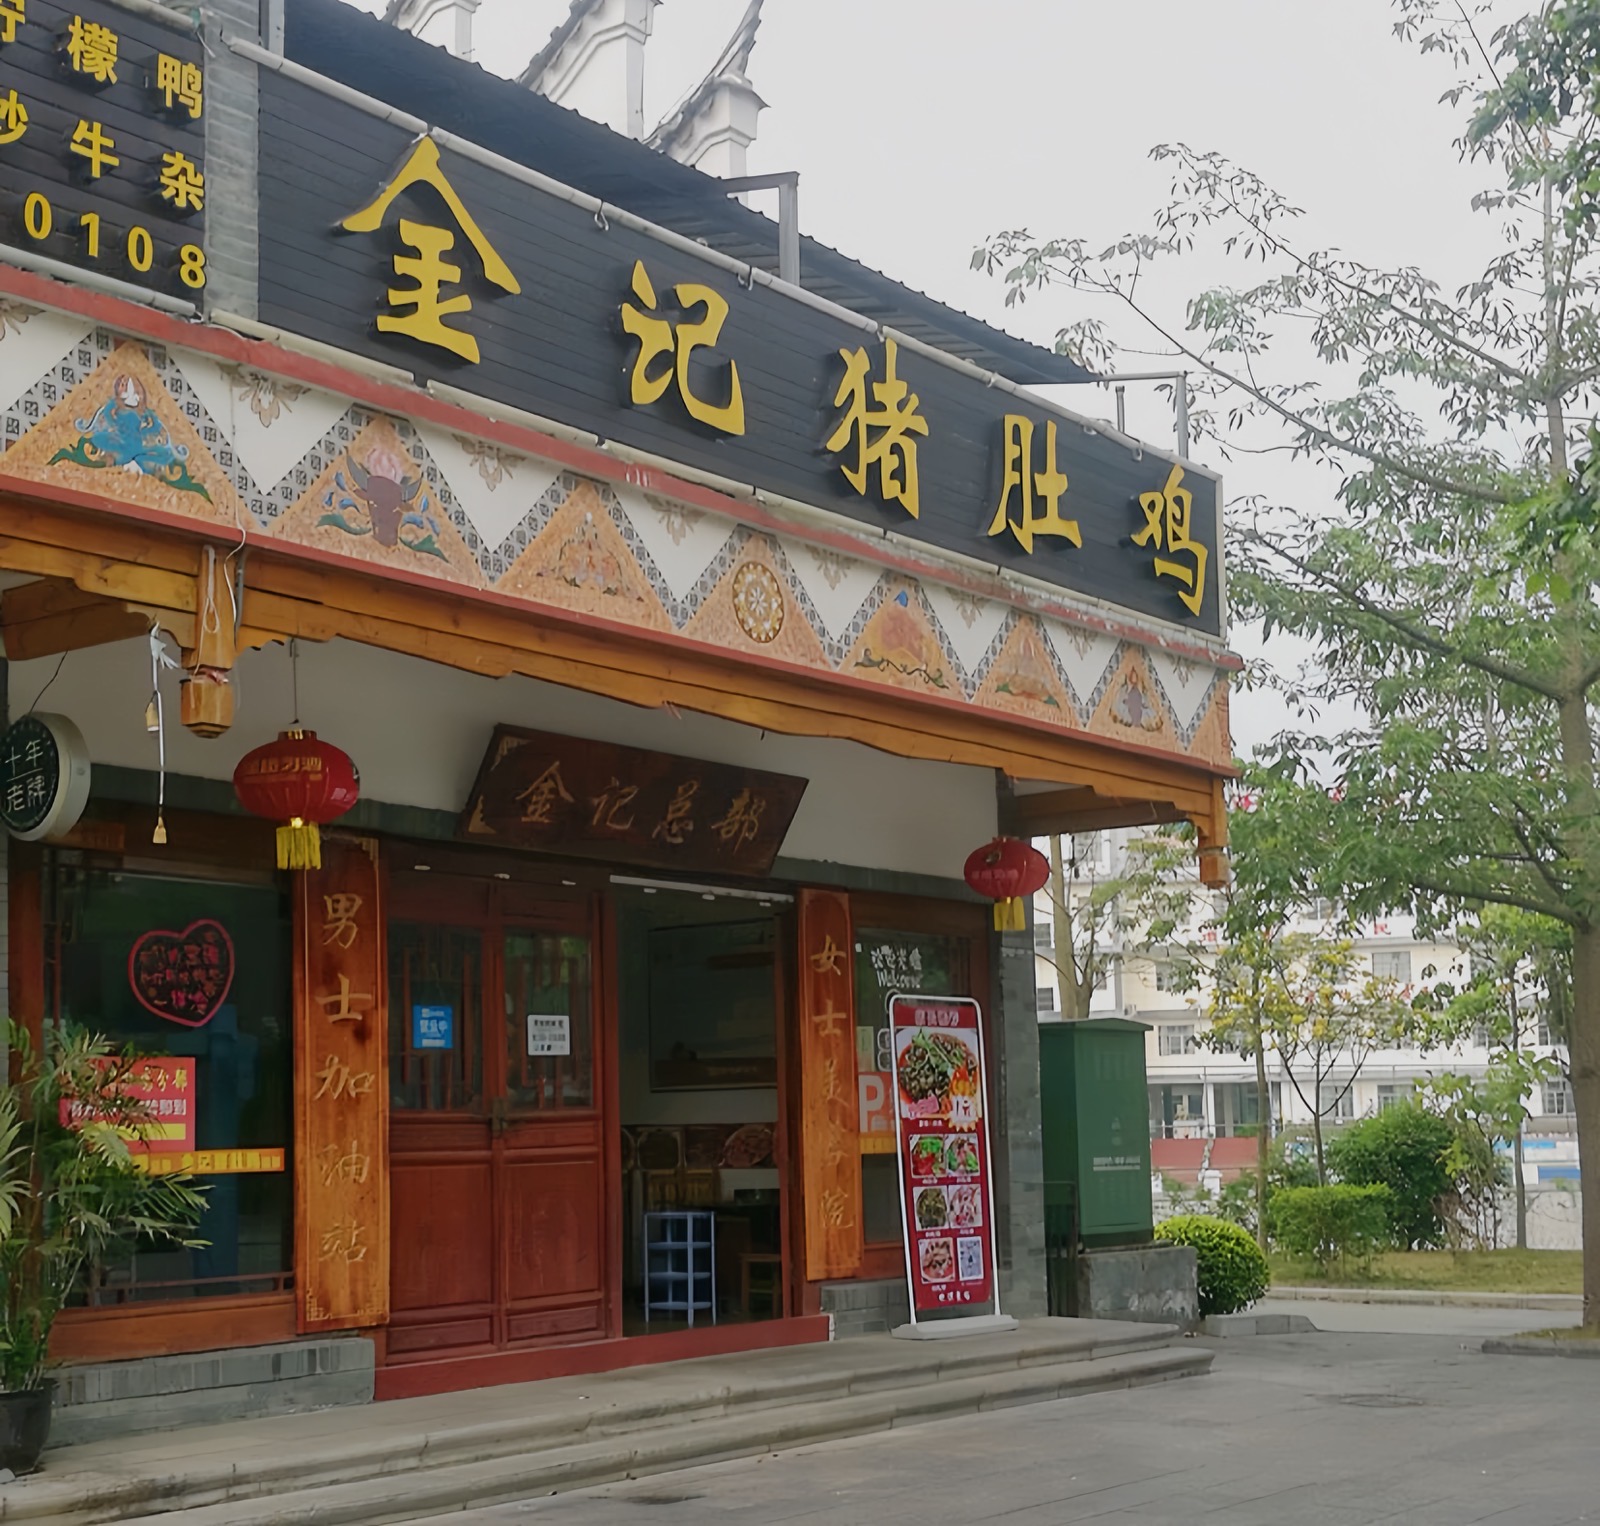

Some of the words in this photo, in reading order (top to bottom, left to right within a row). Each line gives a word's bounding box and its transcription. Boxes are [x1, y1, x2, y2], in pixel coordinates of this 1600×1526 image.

[342, 136, 1207, 617] 金记猪肚鸡
[5, 740, 43, 776] 十年
[314, 892, 376, 1264] 男士加油站
